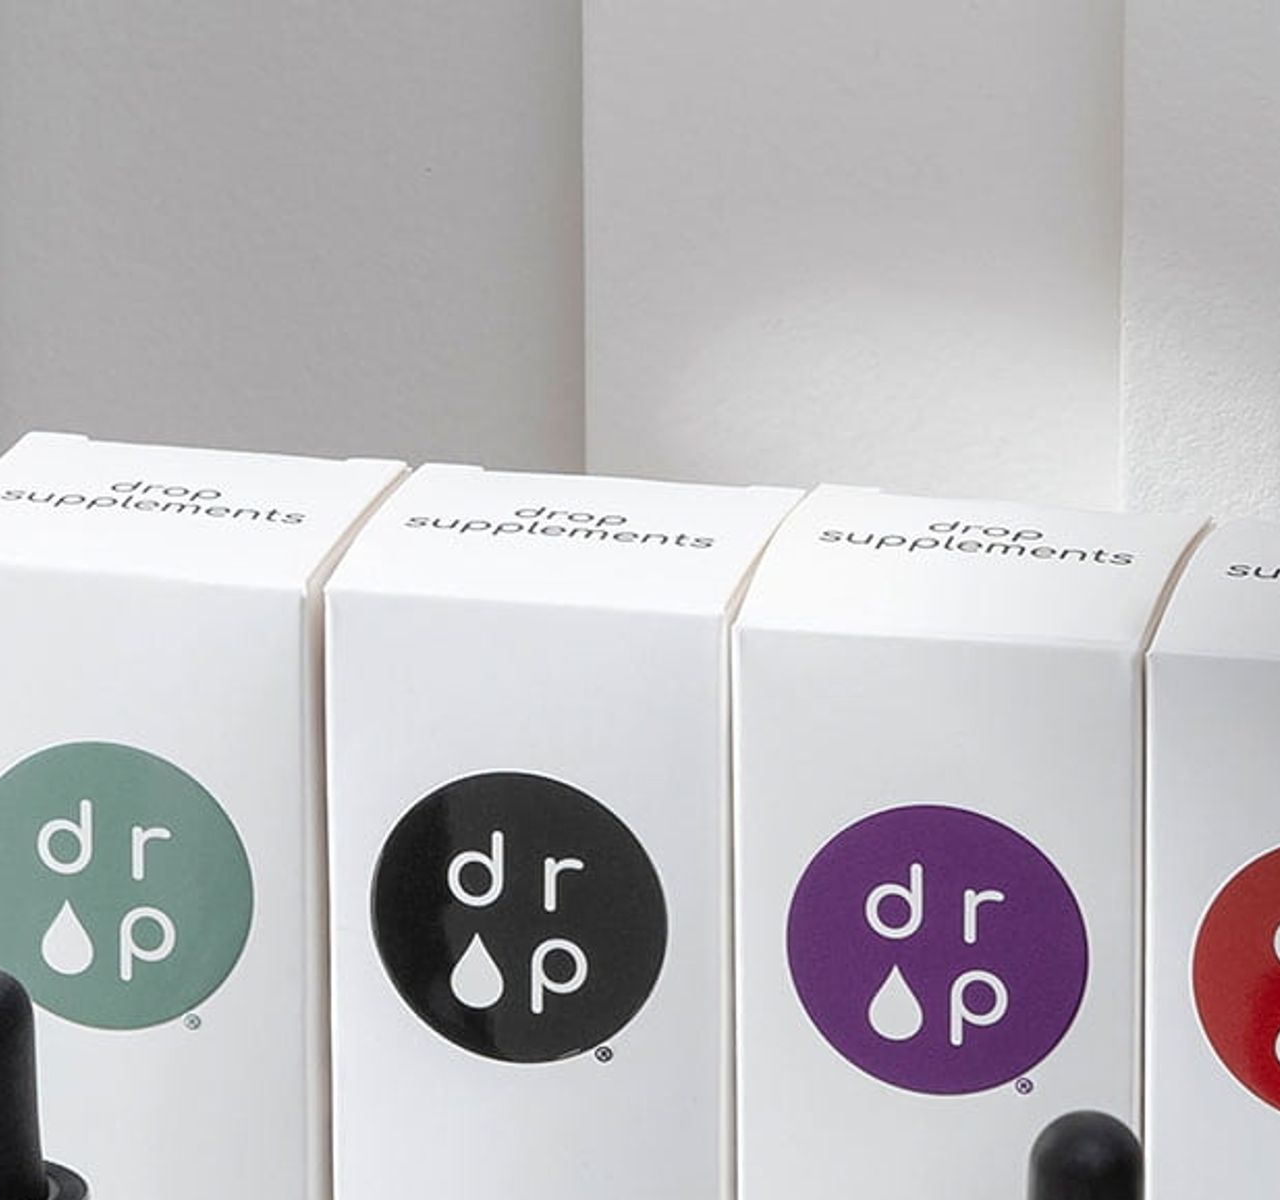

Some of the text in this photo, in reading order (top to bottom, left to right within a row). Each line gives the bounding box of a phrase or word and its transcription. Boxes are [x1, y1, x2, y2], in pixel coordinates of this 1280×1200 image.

[110, 480, 223, 502] drop
[1, 489, 306, 525] supplements
[513, 505, 628, 528] drop
[405, 516, 715, 549] supplements
[928, 519, 1045, 543] drop
[820, 530, 1135, 566] supplements
